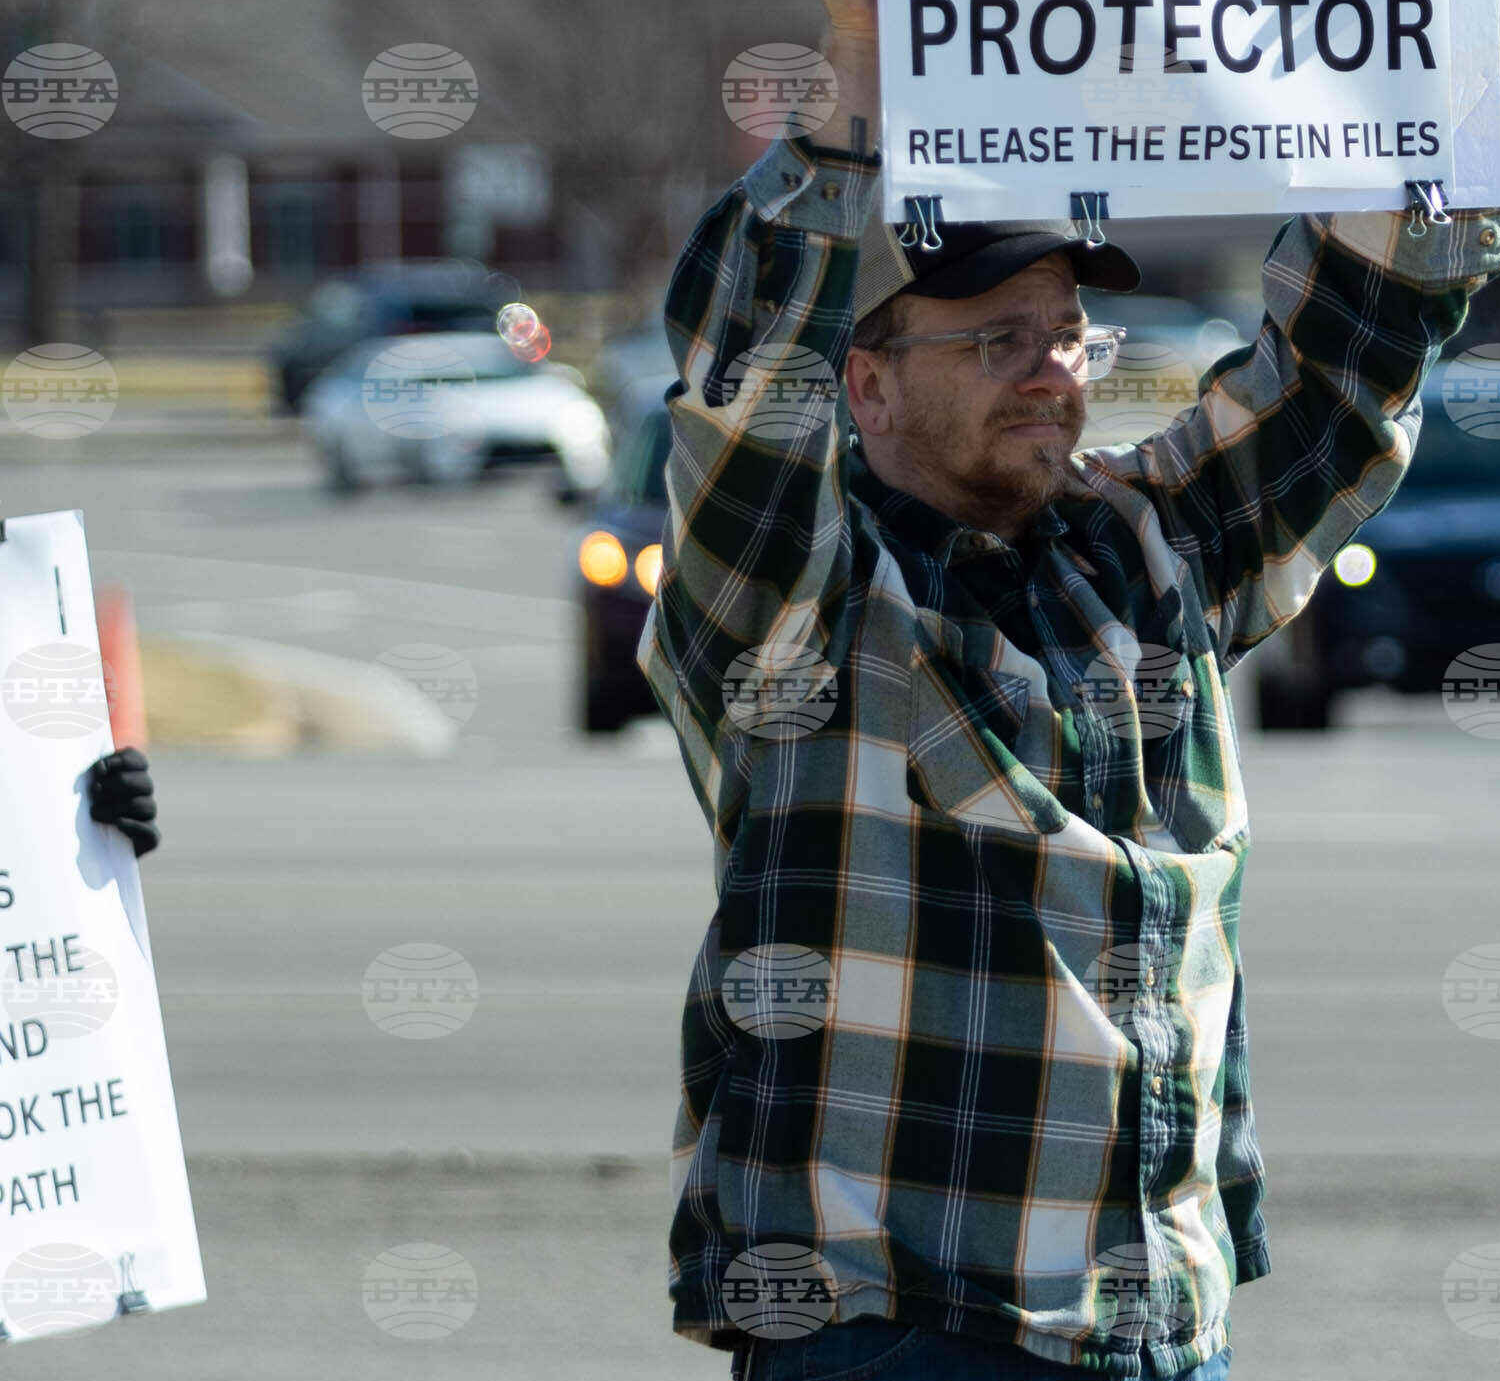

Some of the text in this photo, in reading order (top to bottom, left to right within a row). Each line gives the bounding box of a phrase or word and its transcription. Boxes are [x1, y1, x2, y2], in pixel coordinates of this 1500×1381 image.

[909, 120, 1440, 164] RELEASE THE EPSTEIN FILES
[6, 934, 84, 982] THE
[52, 1078, 128, 1128] THE
[0, 1163, 79, 1216] ATH
